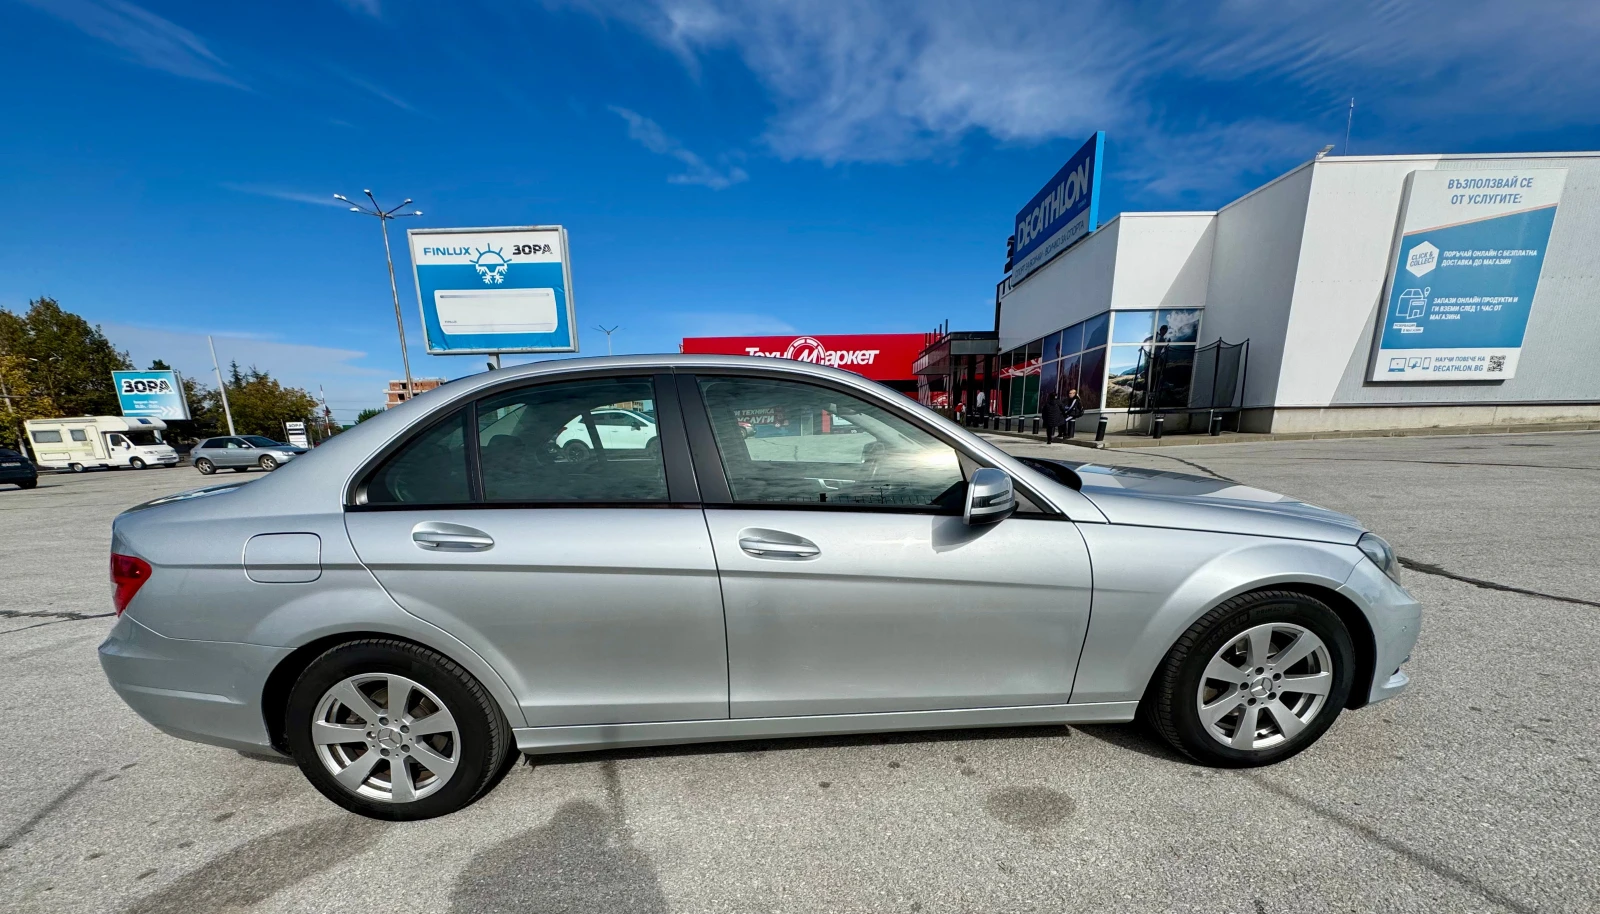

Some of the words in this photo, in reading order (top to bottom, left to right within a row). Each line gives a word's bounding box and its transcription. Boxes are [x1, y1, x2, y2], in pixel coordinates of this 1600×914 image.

[1448, 176, 1518, 189] ВЪЗПОЛЗВАЙ
[1520, 177, 1534, 188] СЕ
[1451, 194, 1465, 204] ОТ
[1467, 193, 1522, 204] УСЛУГИТЕ:
[1017, 156, 1090, 252] DECATHLON
[423, 246, 472, 256] FINLUX
[512, 243, 553, 255] ЗОРА
[1472, 249, 1497, 257] ОНЛАЙН
[1503, 249, 1537, 257] БЕЗПЛАТНА
[1411, 251, 1429, 261] CLICK
[1409, 256, 1435, 268] COLLECT
[1441, 259, 1472, 267] ДОСТАВКА
[1473, 259, 1482, 267] ДО
[1457, 296, 1481, 304] ОНЛАЙН
[1481, 296, 1513, 304] ПРОДУКТИ
[1433, 364, 1484, 372] DECATHLON.BG
[123, 380, 173, 393] ЗОРА
[742, 408, 774, 416] ТЕХНИКА
[1200, 613, 1249, 653] MICHELIN
